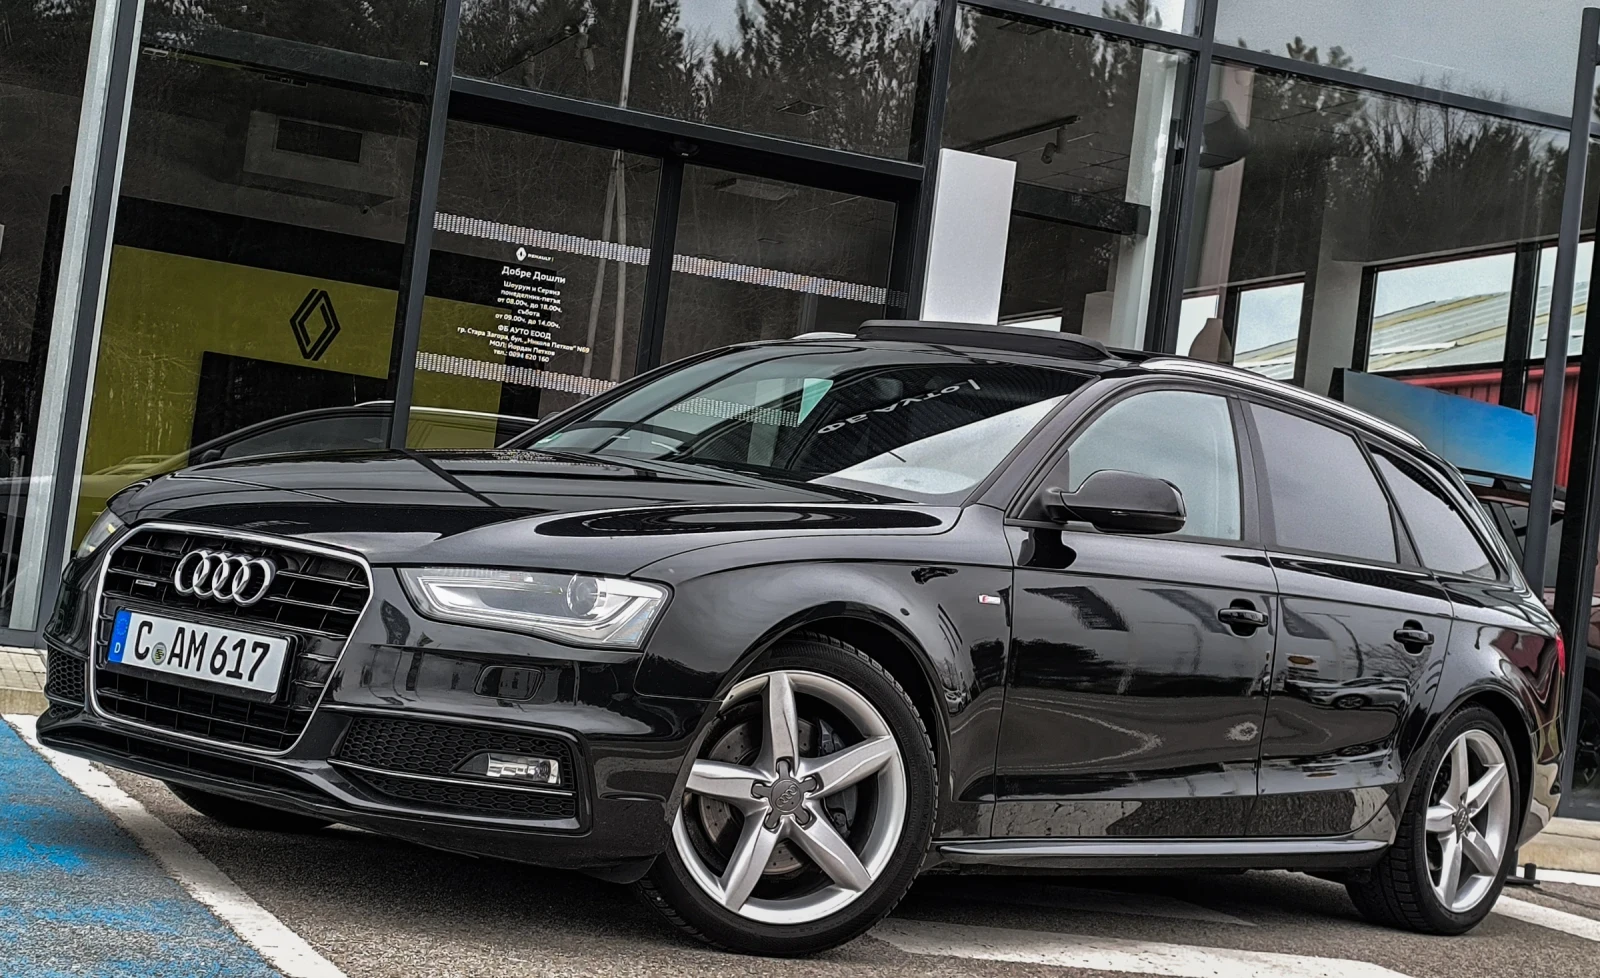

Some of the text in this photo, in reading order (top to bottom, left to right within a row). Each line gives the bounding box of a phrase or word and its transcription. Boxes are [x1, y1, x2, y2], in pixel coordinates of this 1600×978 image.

[502, 265, 566, 284] Добре Дошли
[503, 280, 531, 291] Шоурум
[517, 308, 541, 318] събота
[457, 326, 467, 334] гр.
[467, 327, 486, 337] Стара
[510, 334, 524, 344] бул.
[497, 324, 552, 340] ФБ АУТО ЕООД
[507, 341, 532, 352] Йордан
[533, 346, 556, 356] Петков
[113, 642, 121, 654] D
[134, 620, 271, 682] C AM 617
